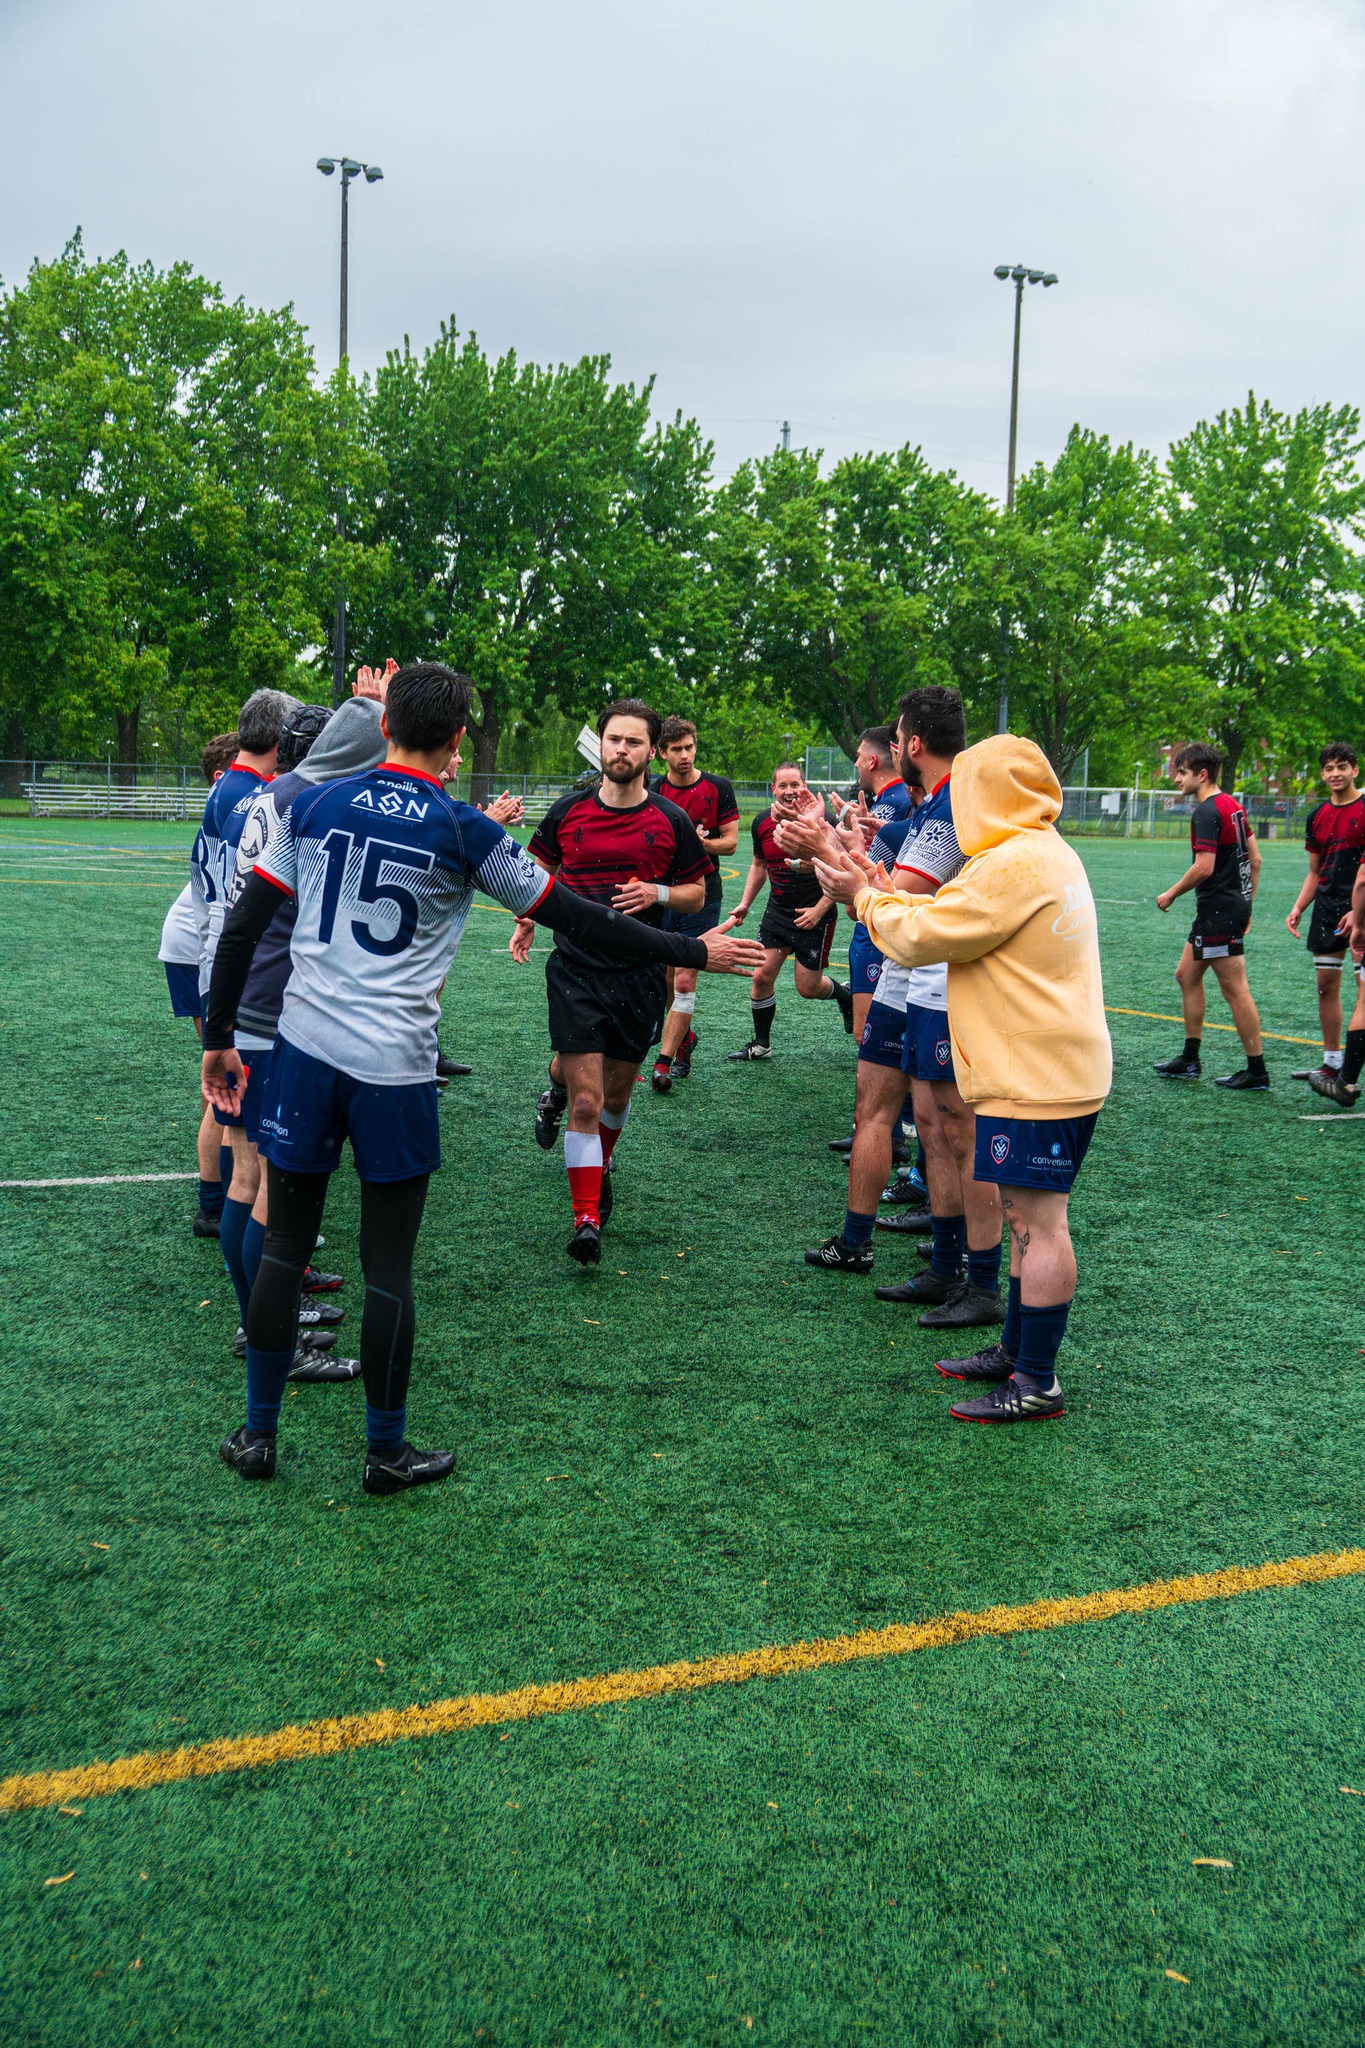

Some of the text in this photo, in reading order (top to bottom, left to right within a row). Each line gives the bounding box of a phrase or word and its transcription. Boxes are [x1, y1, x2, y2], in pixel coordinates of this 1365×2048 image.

[913, 842, 943, 856] equinox
[316, 828, 436, 957] 15
[1032, 1156, 1072, 1167] conversion
